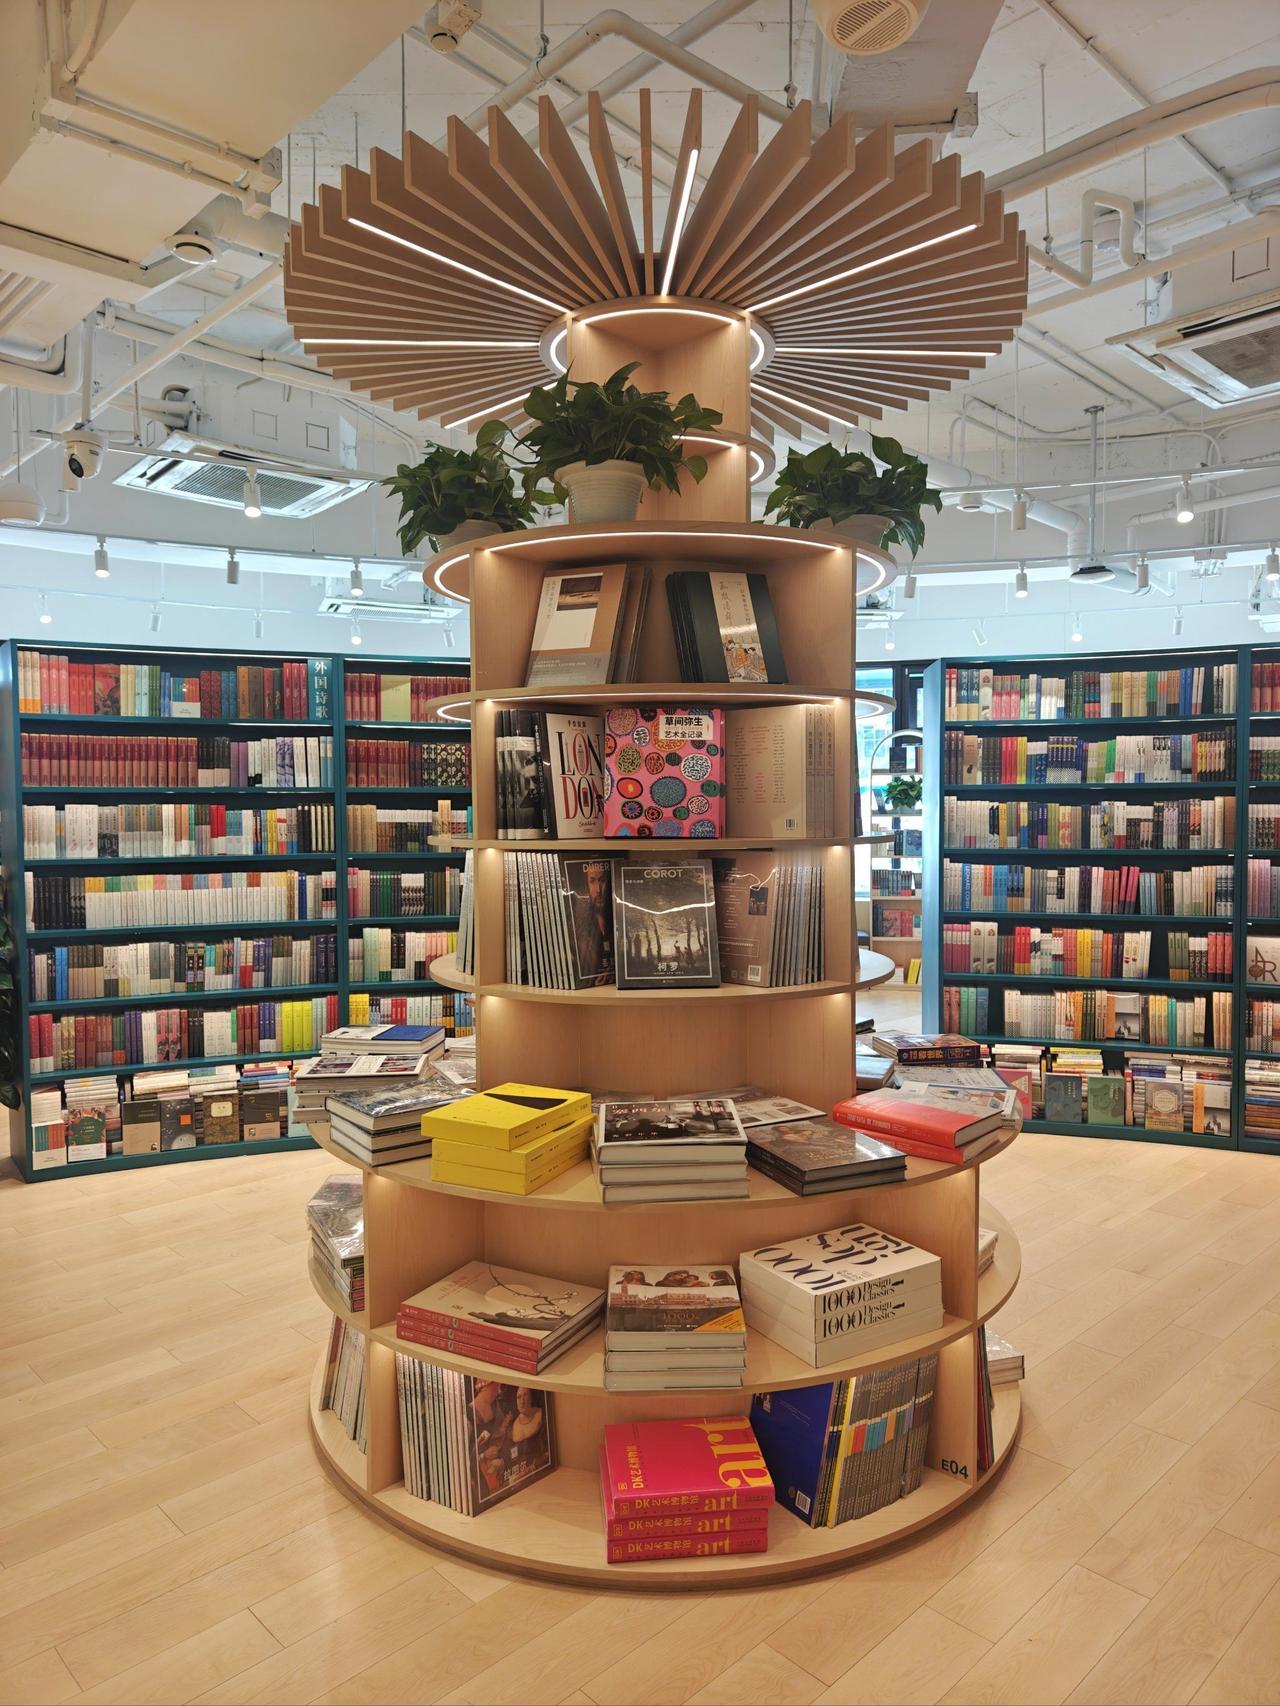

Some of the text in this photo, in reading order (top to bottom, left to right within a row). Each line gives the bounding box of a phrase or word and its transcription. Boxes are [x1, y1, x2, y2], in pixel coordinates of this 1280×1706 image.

[313, 660, 328, 719] 外国诗歌
[664, 716, 703, 726] 草间弥生
[664, 731, 703, 739] 艺术全记录
[643, 869, 683, 878] COROT
[657, 961, 679, 971] 柯罗
[823, 1277, 892, 1314] 1000 Design
[862, 1286, 895, 1302] Classics
[823, 1301, 892, 1338] 1000 Design
[863, 1311, 896, 1326] Classics
[681, 1416, 773, 1489] art
[942, 1458, 969, 1480] E04
[704, 1491, 738, 1512] art
[697, 1513, 732, 1533] art
[696, 1535, 731, 1555] art
